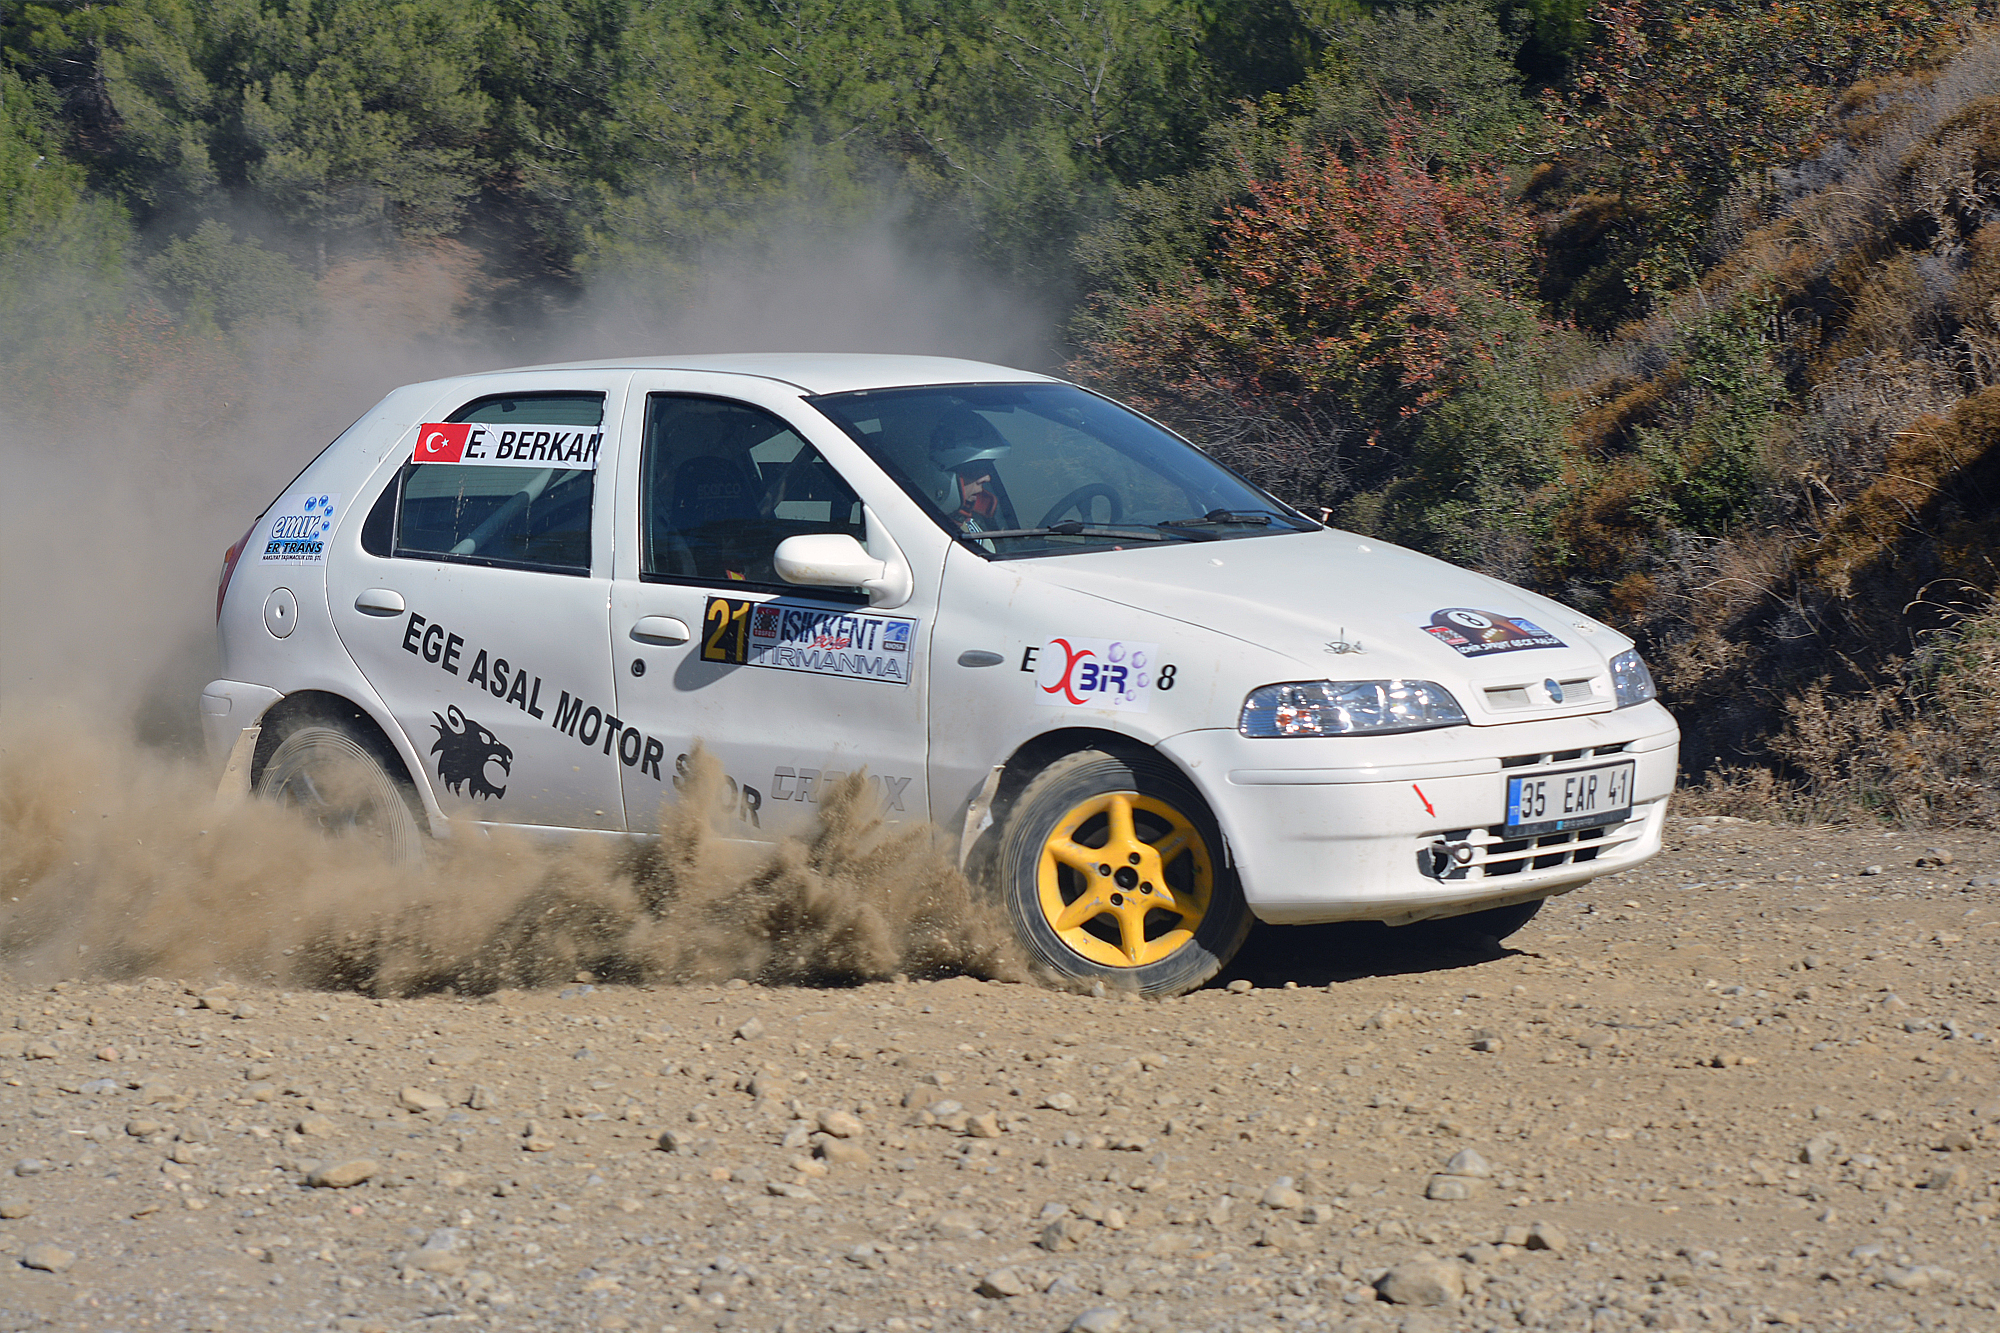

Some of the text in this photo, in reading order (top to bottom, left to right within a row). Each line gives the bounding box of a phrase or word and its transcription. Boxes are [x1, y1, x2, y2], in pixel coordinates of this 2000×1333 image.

[465, 430, 486, 459] E.
[265, 541, 323, 554] ER TRANS
[705, 599, 750, 662] 21
[754, 628, 776, 638] TOSFED
[1455, 612, 1485, 627] 8
[752, 643, 902, 679] TIRMANMA
[1156, 664, 1177, 691] 8
[402, 611, 762, 829] EGE ASAL MOTOR SOR
[1522, 769, 1627, 818] 35 EAR 41
